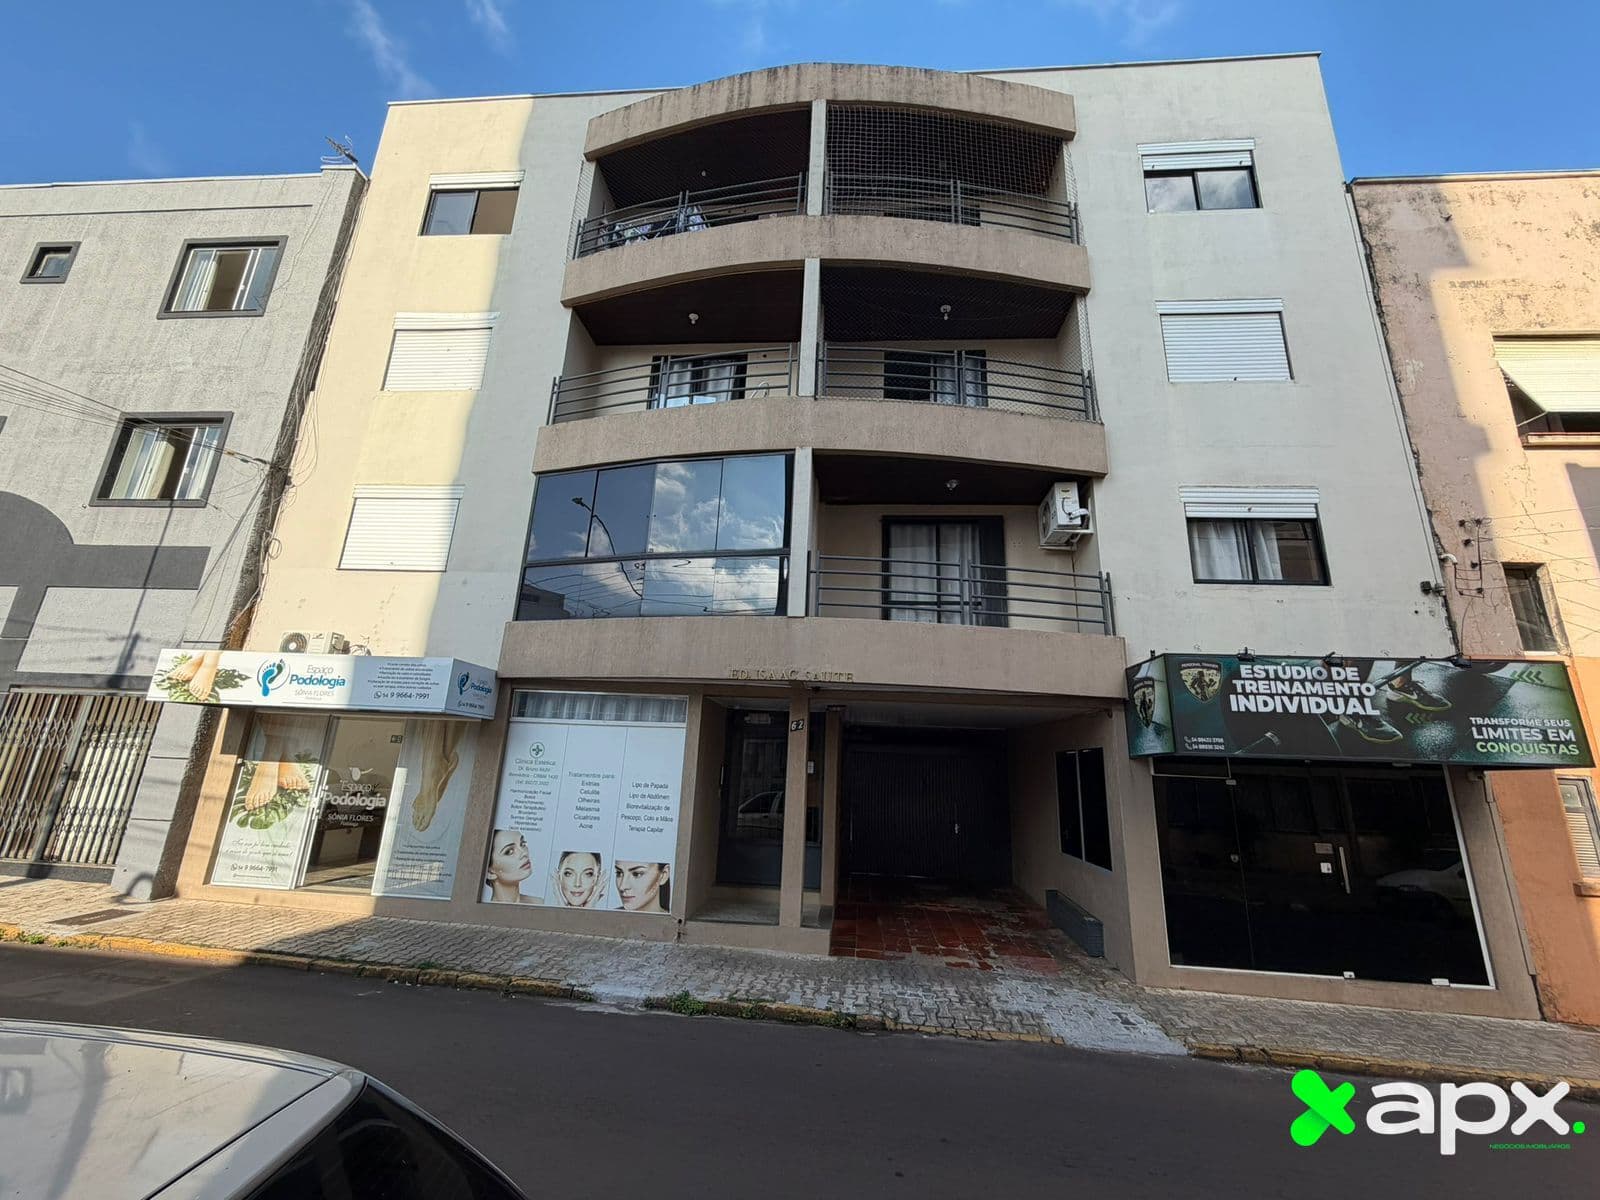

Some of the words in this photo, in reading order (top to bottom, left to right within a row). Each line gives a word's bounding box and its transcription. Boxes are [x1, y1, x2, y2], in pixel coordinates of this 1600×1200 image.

[1240, 662, 1328, 680] ESTÚDIO
[1331, 666, 1361, 680] DE
[289, 674, 346, 689] Podologia
[1232, 680, 1377, 697] TREINAMENTO
[1229, 694, 1380, 715] INDIVIDUAL
[790, 720, 804, 731] 62
[1469, 717, 1542, 727] TRANSFORME
[1544, 719, 1572, 727] SEUS
[1472, 727, 1543, 740] LIMITES
[1547, 729, 1577, 742] EM
[1476, 741, 1580, 755] CONQUISTAS
[341, 780, 372, 794] Espaço
[650, 782, 669, 790] Papada
[324, 792, 387, 810] Podologia
[629, 792, 639, 800] Lipo
[328, 812, 348, 821] SÔNIA
[349, 814, 374, 822] FLORES
